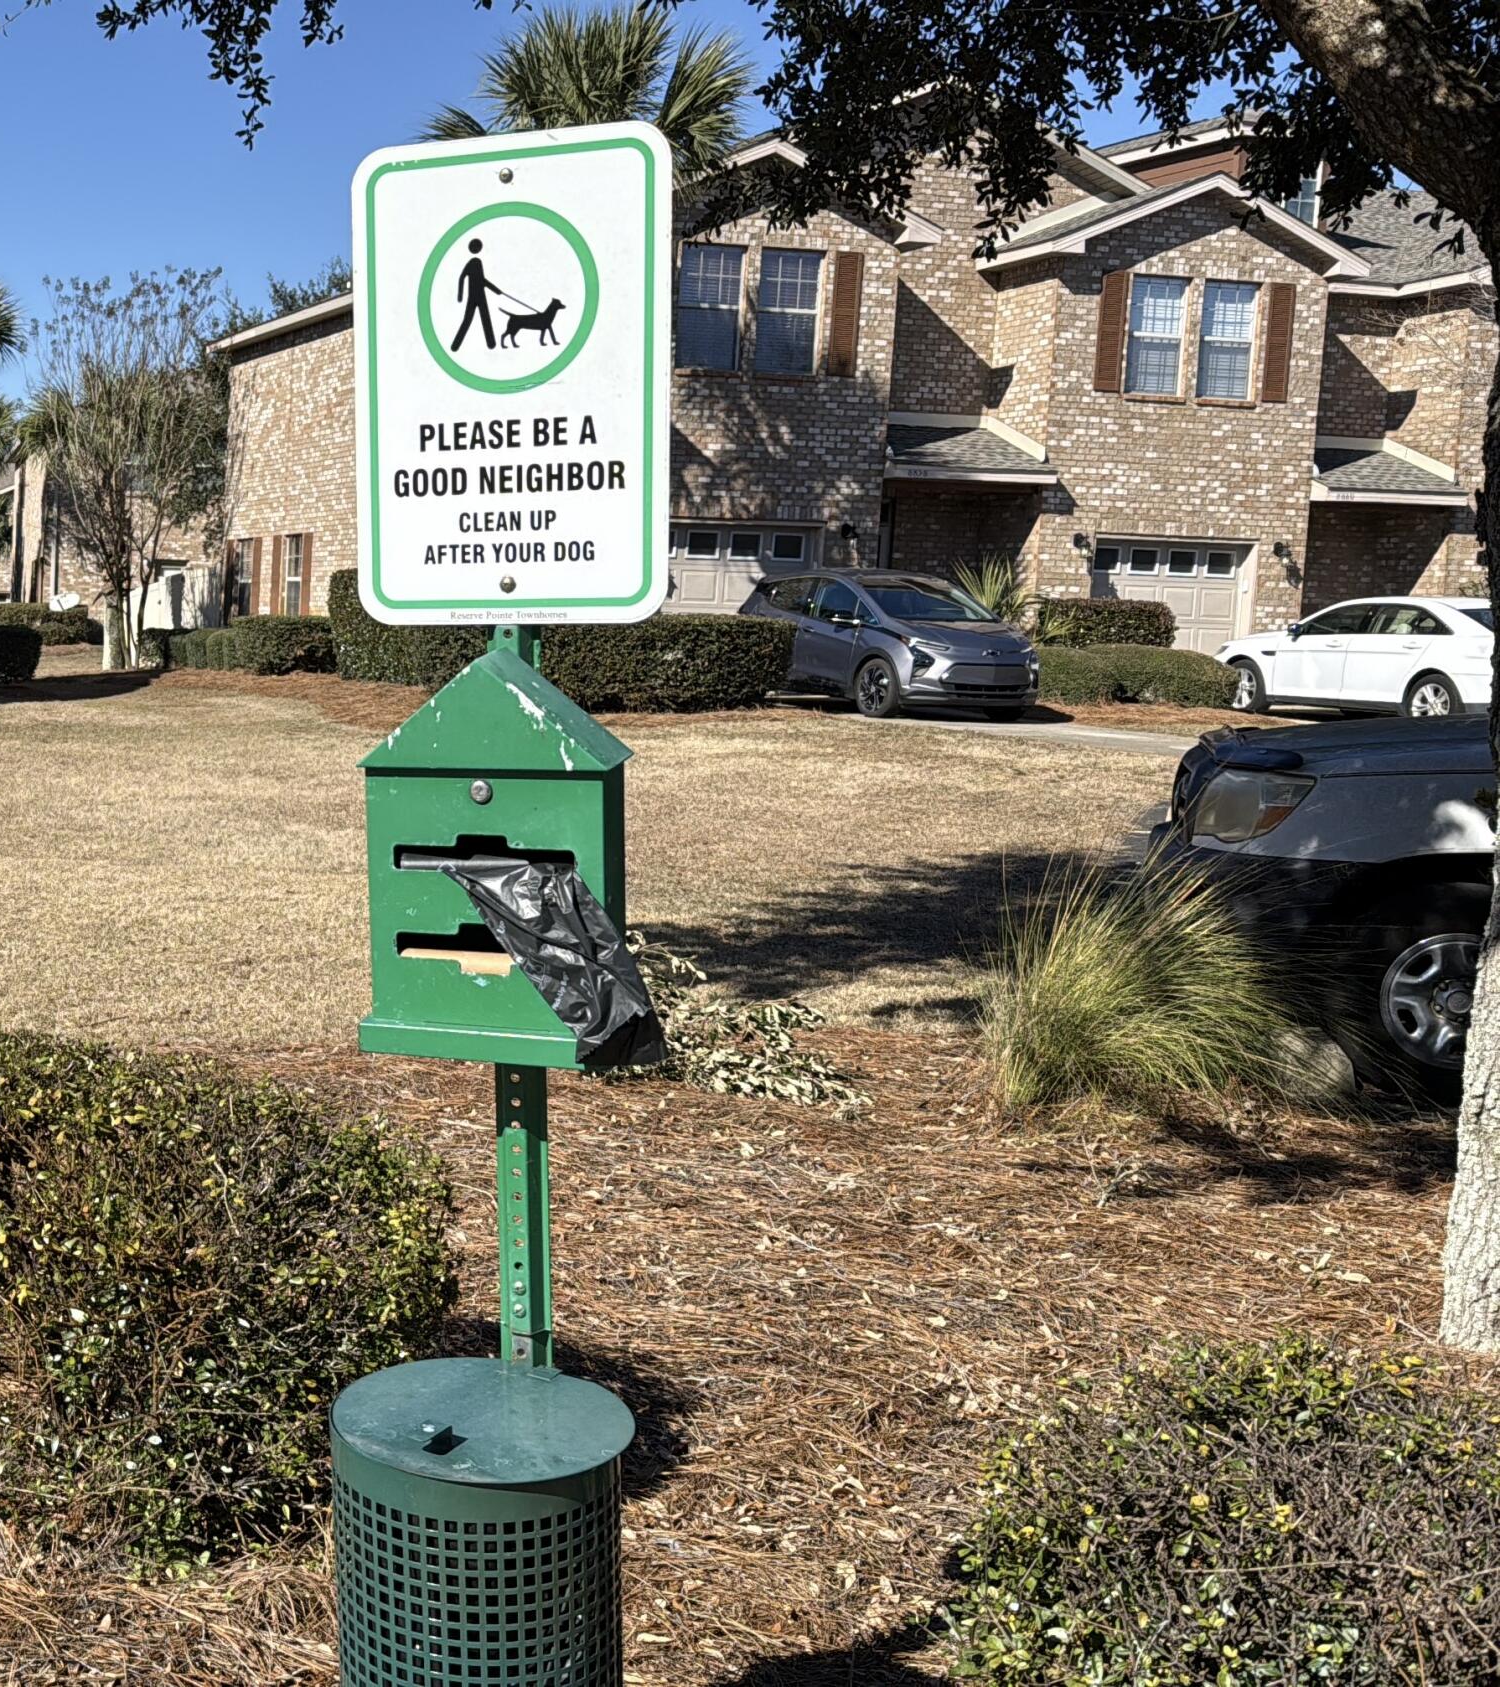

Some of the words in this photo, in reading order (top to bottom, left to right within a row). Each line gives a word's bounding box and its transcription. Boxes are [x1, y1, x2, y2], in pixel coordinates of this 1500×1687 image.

[419, 419, 521, 452] PLEASE
[533, 416, 568, 447] BE
[579, 415, 597, 445] A
[394, 467, 468, 498] GOOD
[479, 460, 626, 495] NEIGHBOR
[459, 511, 522, 533] CLEAN
[530, 509, 557, 531] UP
[424, 543, 485, 565] AFTER
[492, 542, 545, 563] YOUR
[554, 540, 595, 562] DOG
[450, 611, 483, 620] Reserve
[486, 611, 513, 619] Pointe
[516, 610, 568, 619] Townhomes
